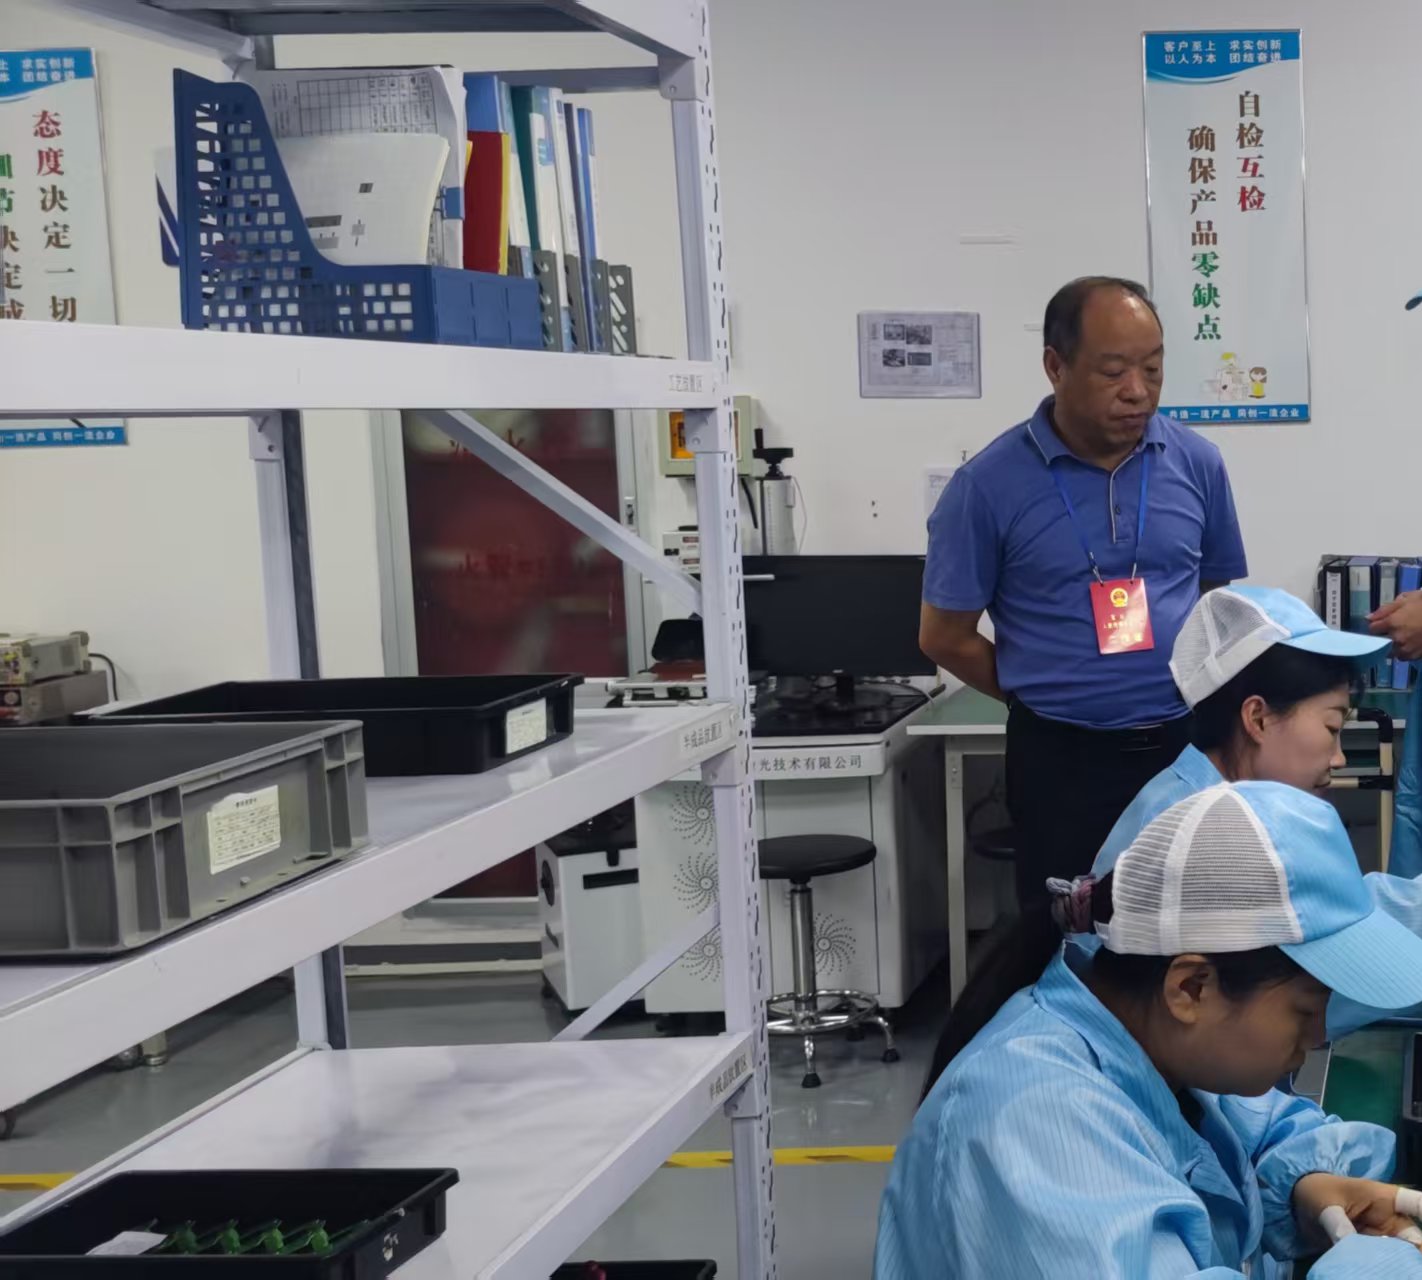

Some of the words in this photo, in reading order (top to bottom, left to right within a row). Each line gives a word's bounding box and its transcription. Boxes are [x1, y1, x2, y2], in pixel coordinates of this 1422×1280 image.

[1164, 53, 1217, 64] 以人为本
[1229, 39, 1281, 51] 求实创新
[1236, 91, 1266, 213] 自检互检
[32, 110, 77, 322] 态度决定一切
[1187, 125, 1221, 341] 确保产品零缺点
[753, 754, 861, 772] 光技术有限公司
